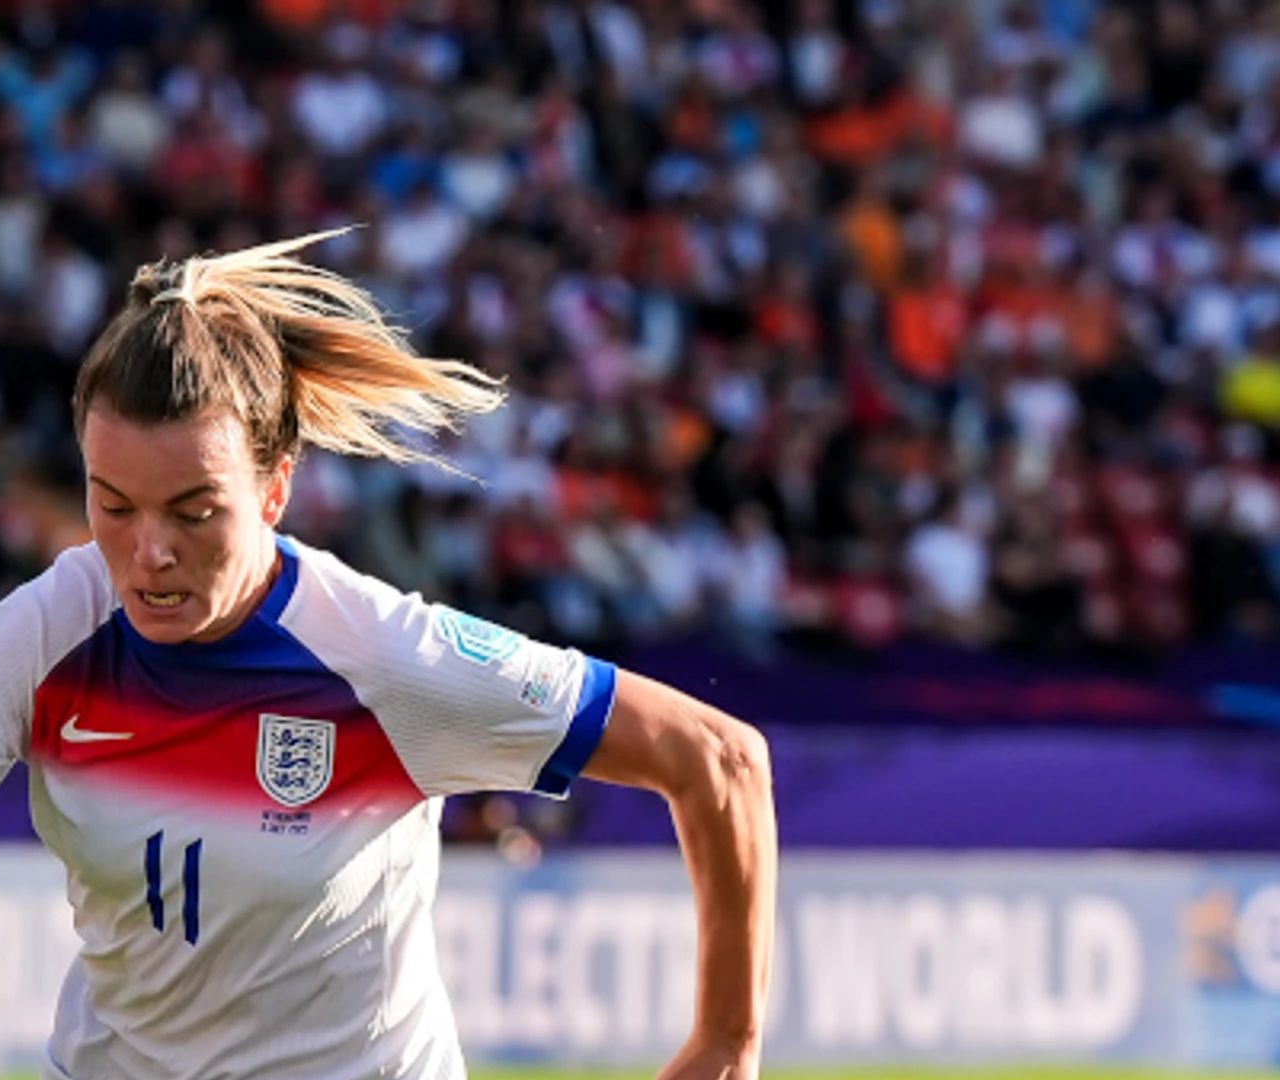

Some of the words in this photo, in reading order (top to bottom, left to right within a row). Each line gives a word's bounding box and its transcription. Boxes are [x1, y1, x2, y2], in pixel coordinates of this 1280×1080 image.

[144, 828, 202, 948] 11
[432, 892, 786, 1042] ELECT
[800, 892, 1144, 1046] WORLD
